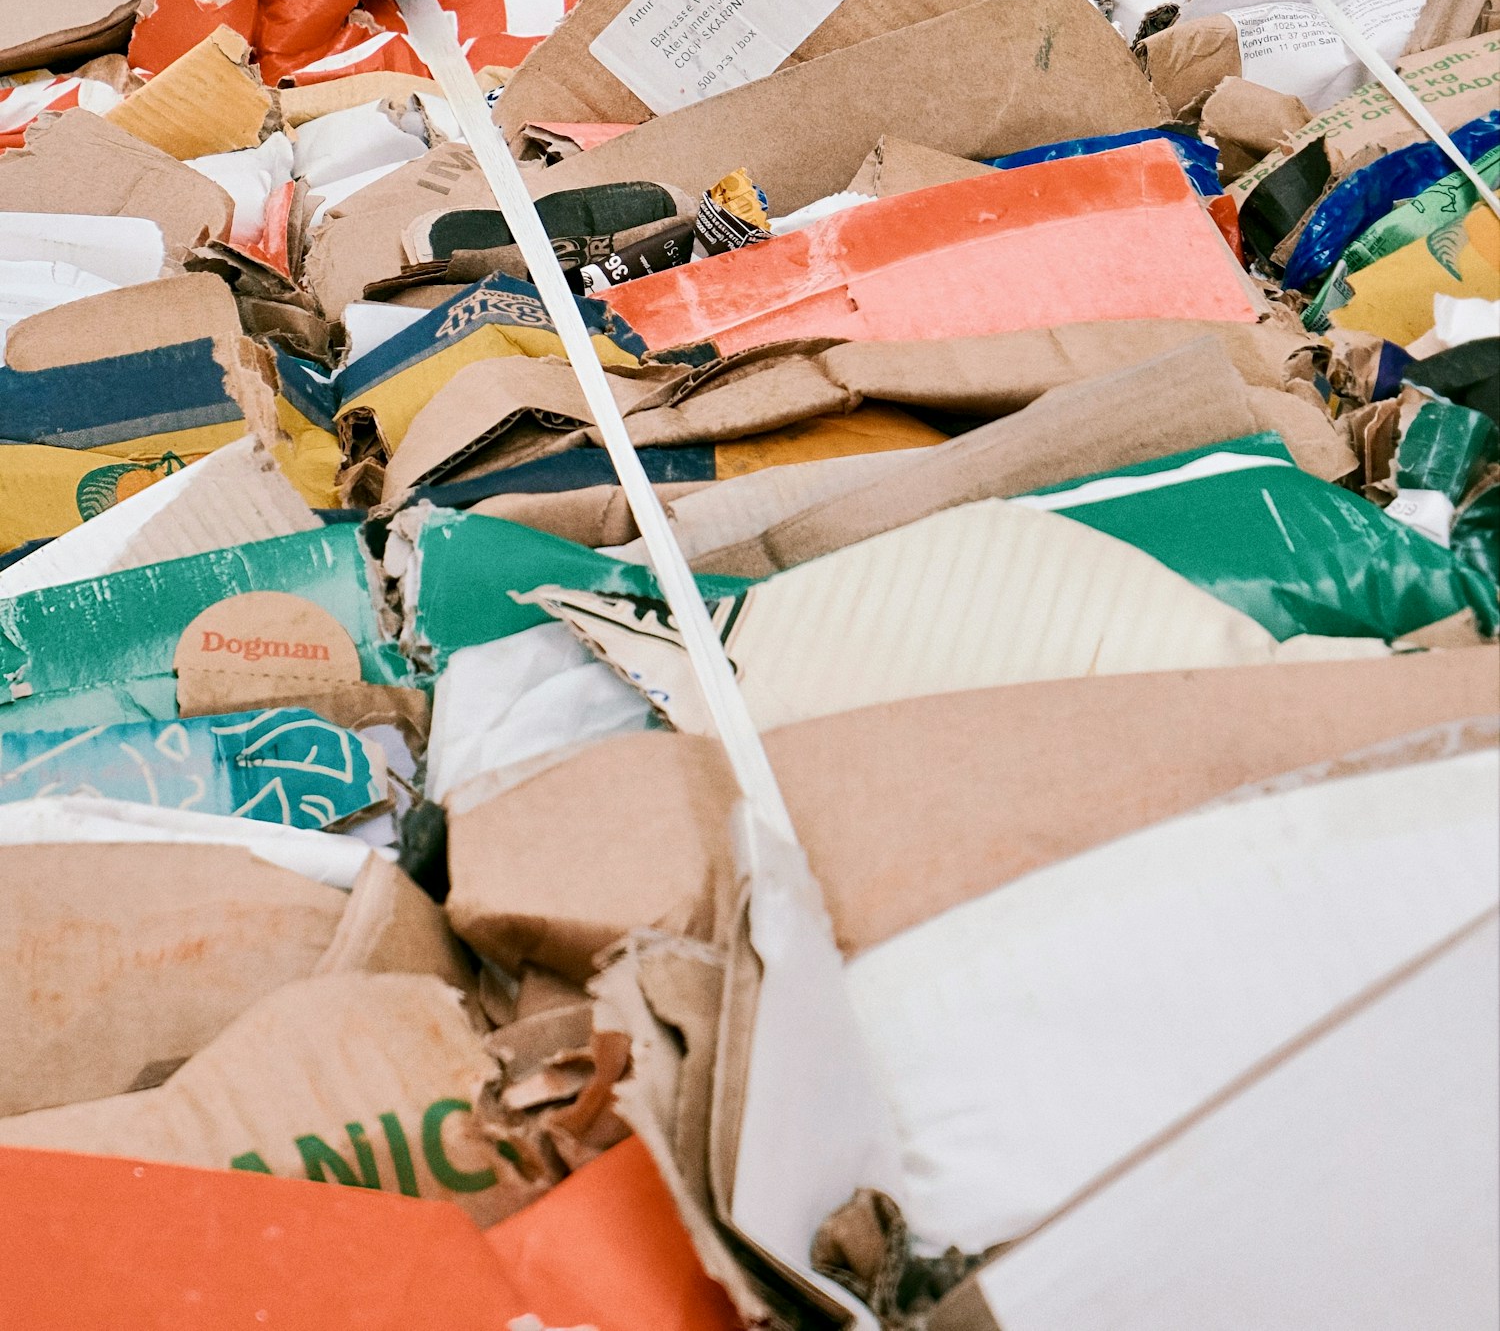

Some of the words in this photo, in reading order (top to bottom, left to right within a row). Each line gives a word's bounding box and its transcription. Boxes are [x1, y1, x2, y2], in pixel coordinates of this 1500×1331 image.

[696, 70, 716, 91] 500
[735, 28, 758, 48] box
[1403, 50, 1481, 82] ength:
[1424, 72, 1459, 88] kg
[1362, 104, 1395, 121] OF
[201, 631, 330, 662] Dogman
